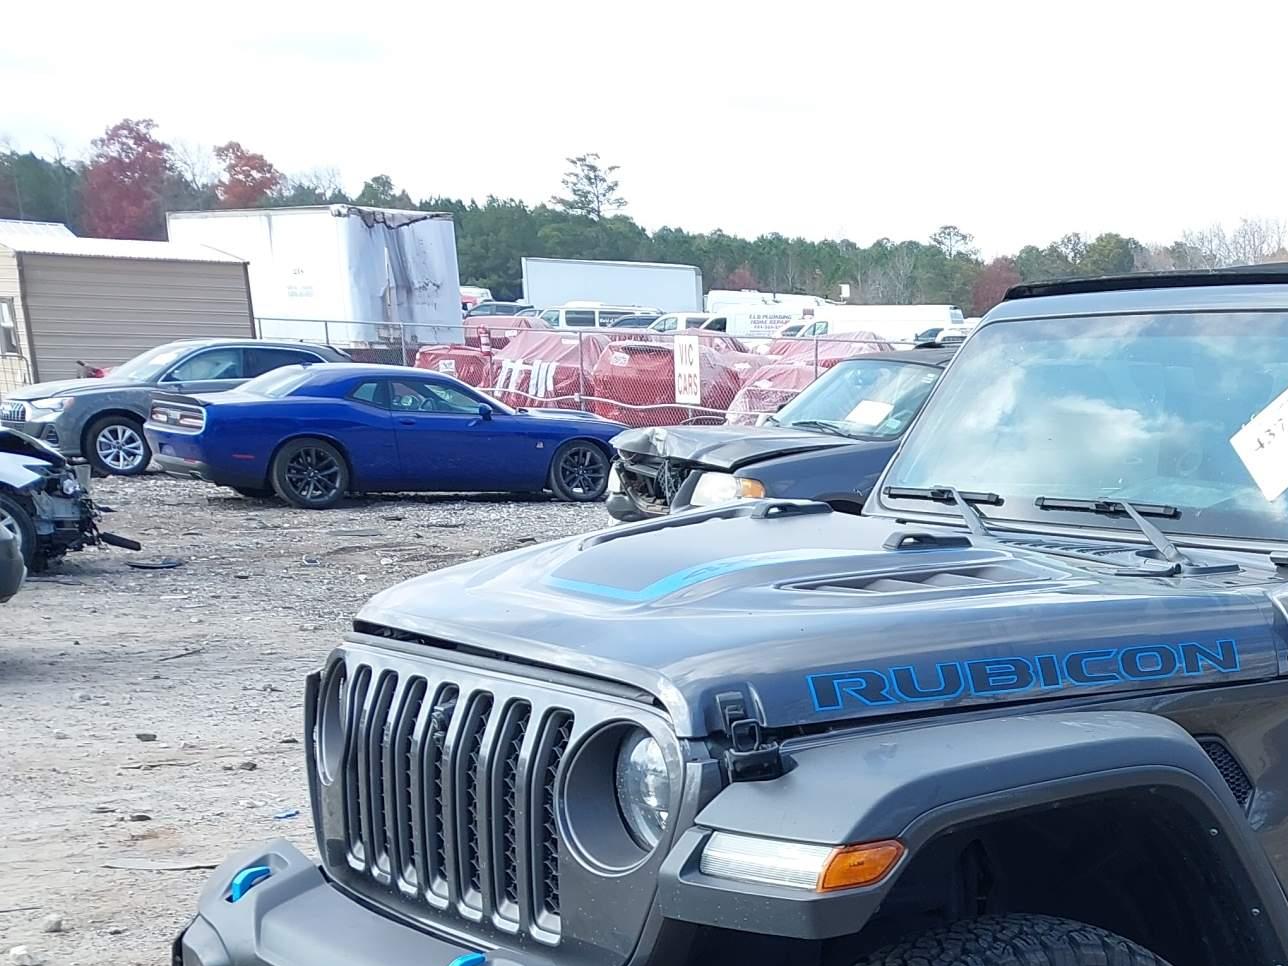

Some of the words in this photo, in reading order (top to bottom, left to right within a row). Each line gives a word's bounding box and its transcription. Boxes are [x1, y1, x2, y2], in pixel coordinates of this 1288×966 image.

[678, 343, 694, 366] VIC
[677, 372, 698, 396] CARS
[806, 639, 1241, 712] RUBICON
